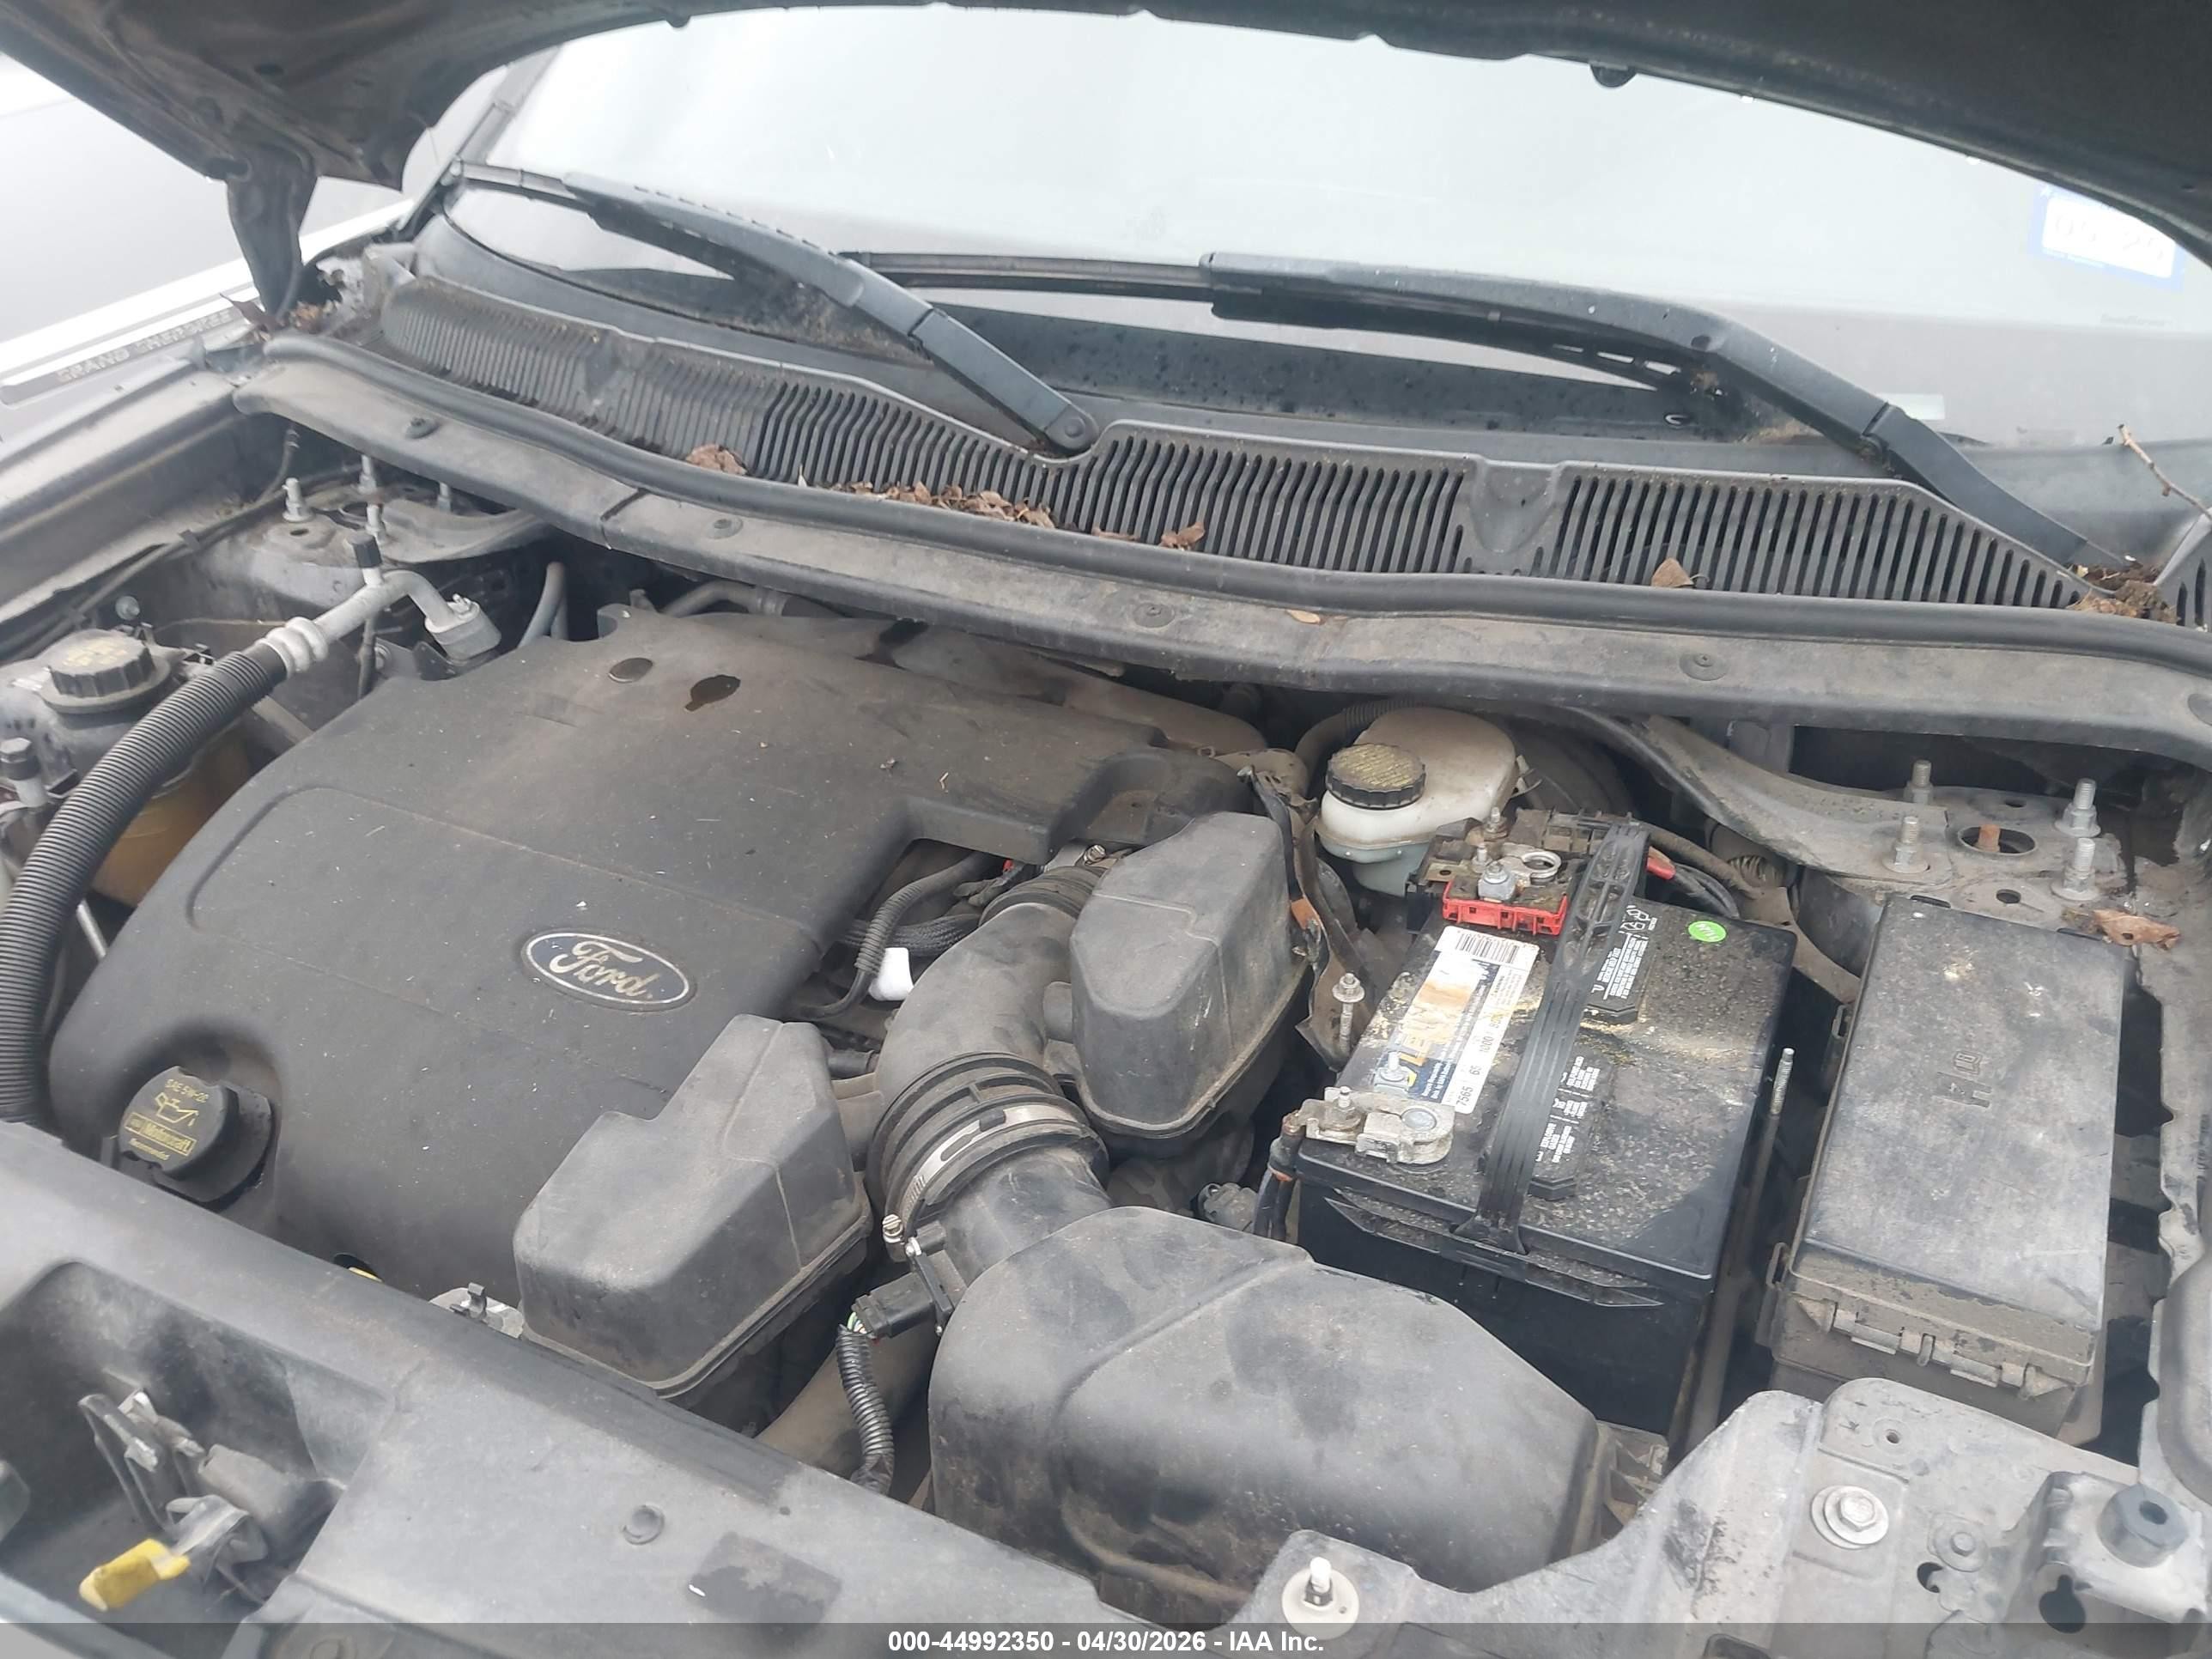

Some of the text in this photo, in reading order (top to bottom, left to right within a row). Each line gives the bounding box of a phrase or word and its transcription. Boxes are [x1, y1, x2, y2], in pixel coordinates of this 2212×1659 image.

[56, 347, 130, 383] GRAND
[549, 940, 661, 997] Ford
[165, 1079, 183, 1092] SAE
[1455, 1085, 1474, 1106] 7565
[1469, 1066, 1482, 1076] 65
